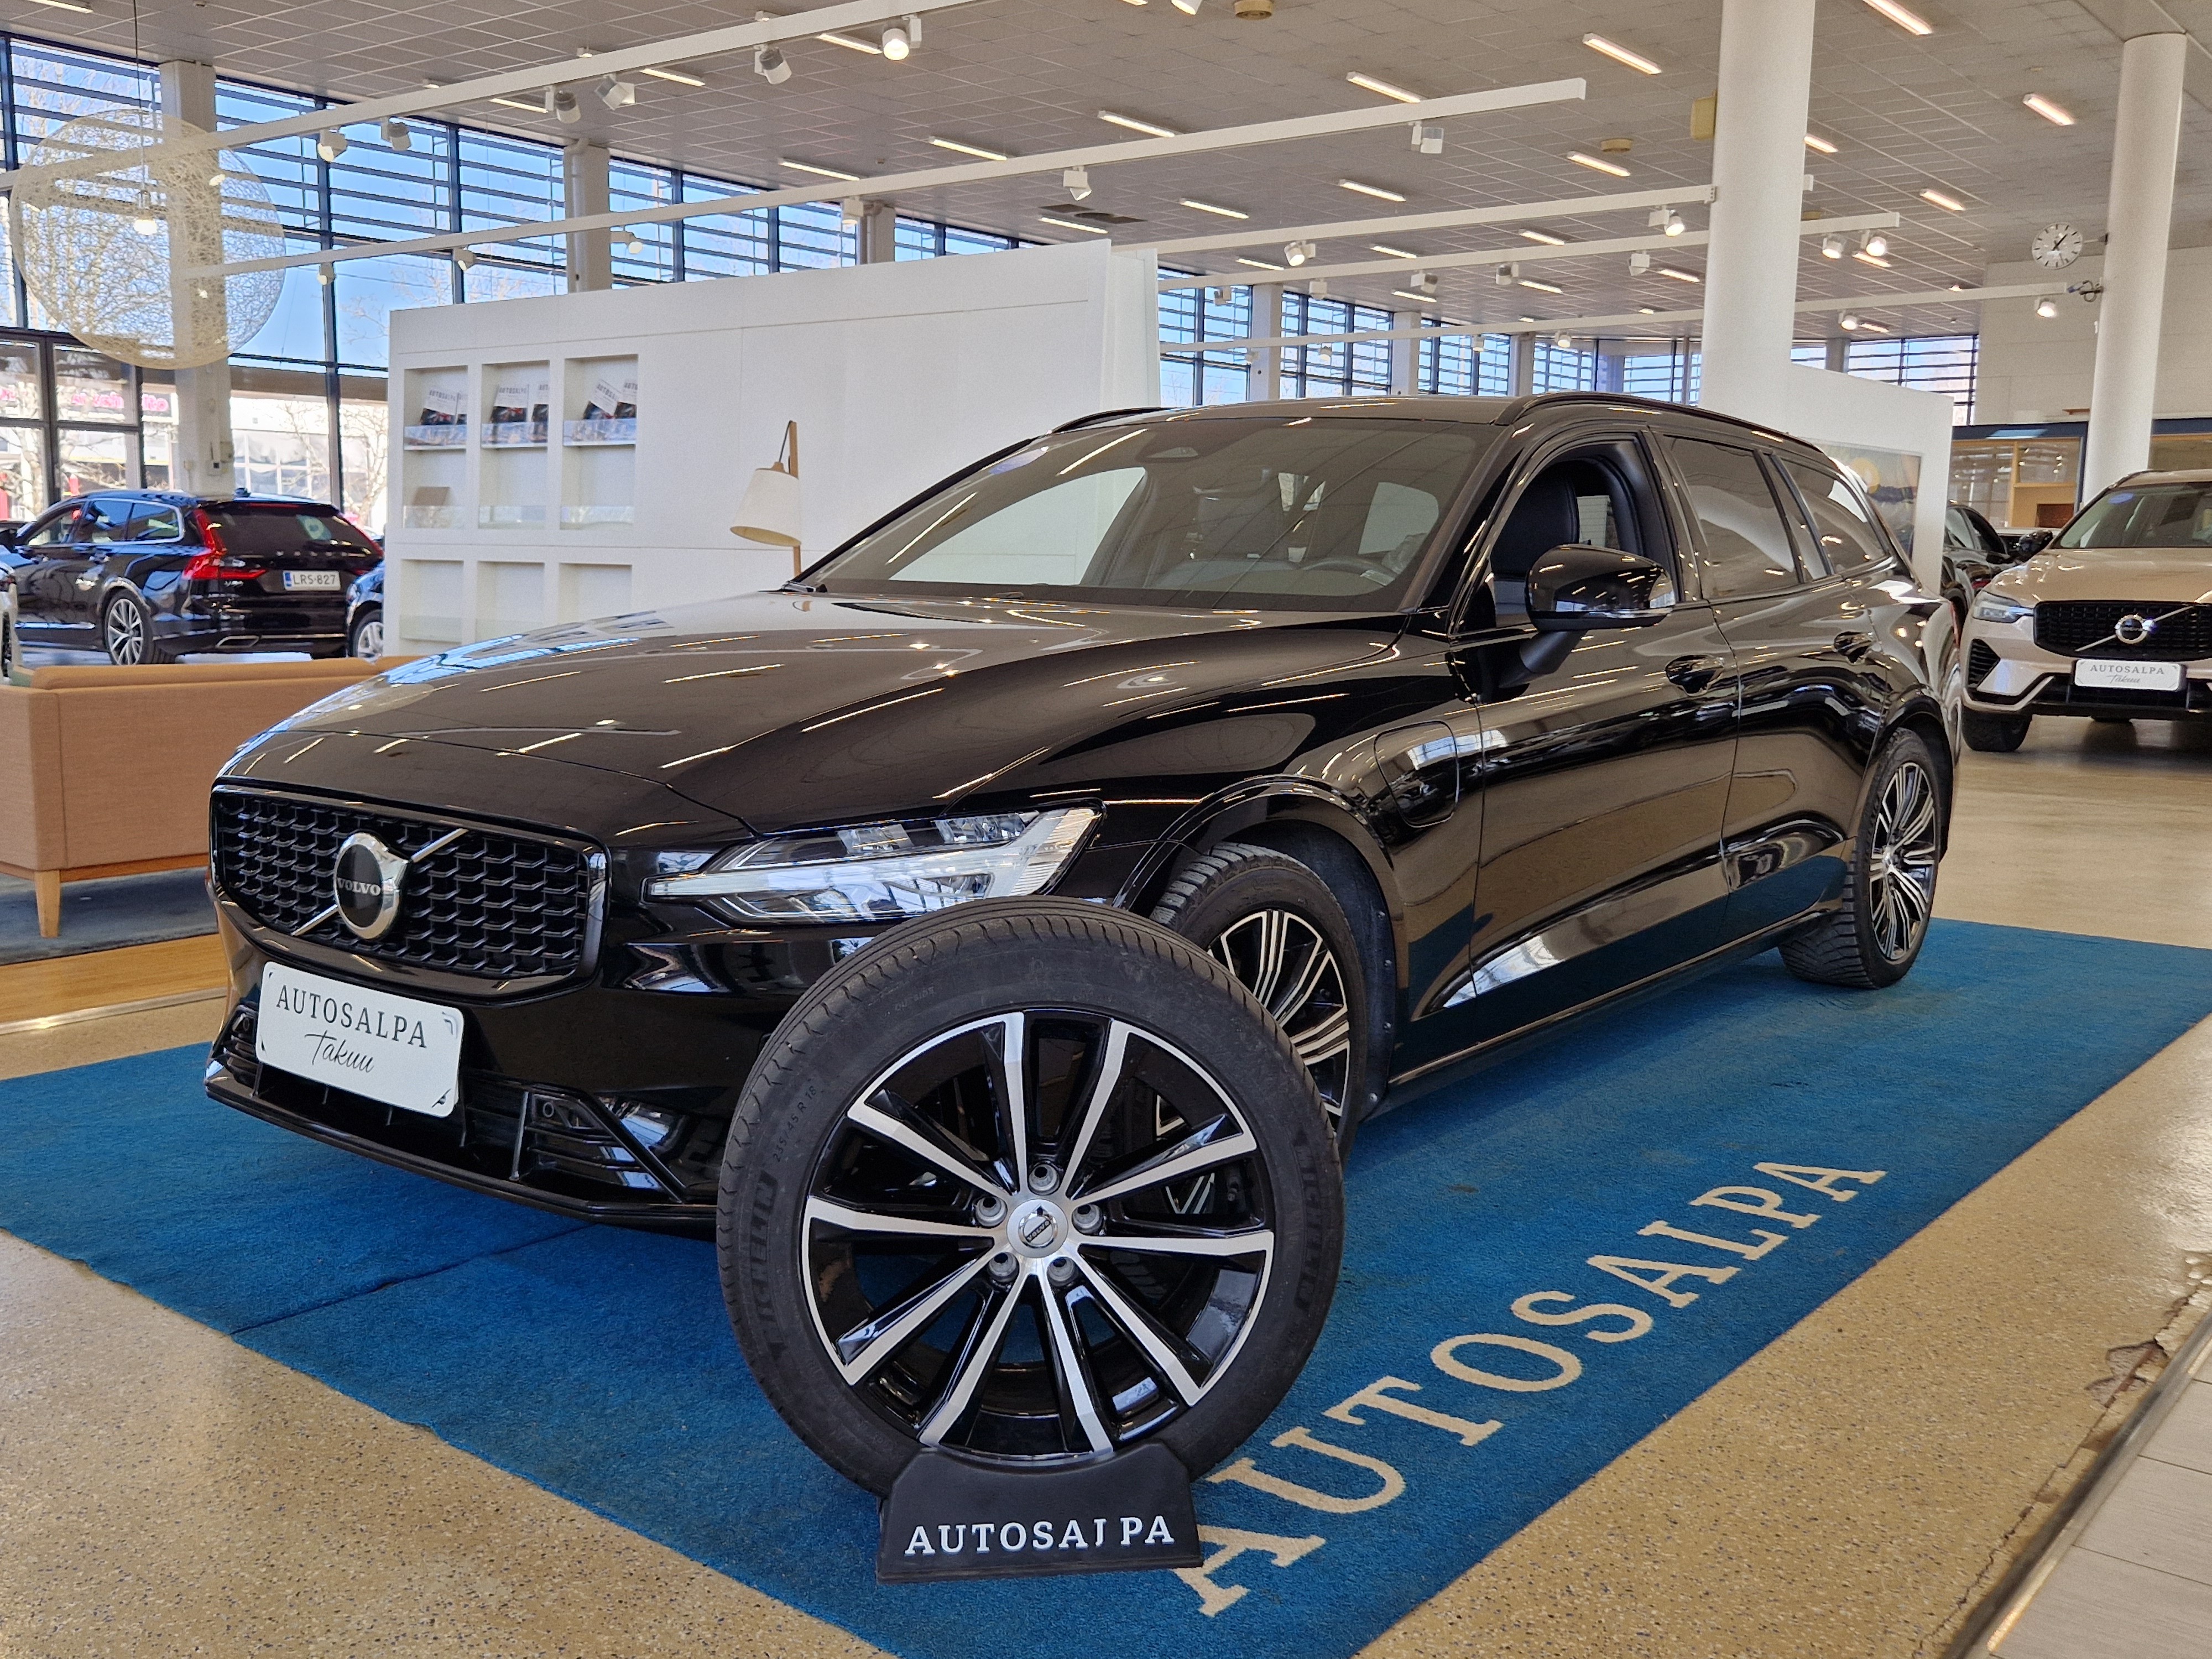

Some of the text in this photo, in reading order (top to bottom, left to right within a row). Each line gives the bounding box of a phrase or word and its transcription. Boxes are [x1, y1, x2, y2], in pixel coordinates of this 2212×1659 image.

[2090, 665, 2165, 675] AUTOSALPA
[2106, 674, 2141, 684] Takuu
[336, 877, 381, 896] VOLVO
[276, 984, 427, 1048] AUTOSALPA
[304, 1029, 374, 1073] Takuu
[1026, 1220, 1051, 1241] VOLVO
[749, 1174, 785, 1343] MICHELIN
[1173, 1161, 1887, 1616] AUTOSALPA
